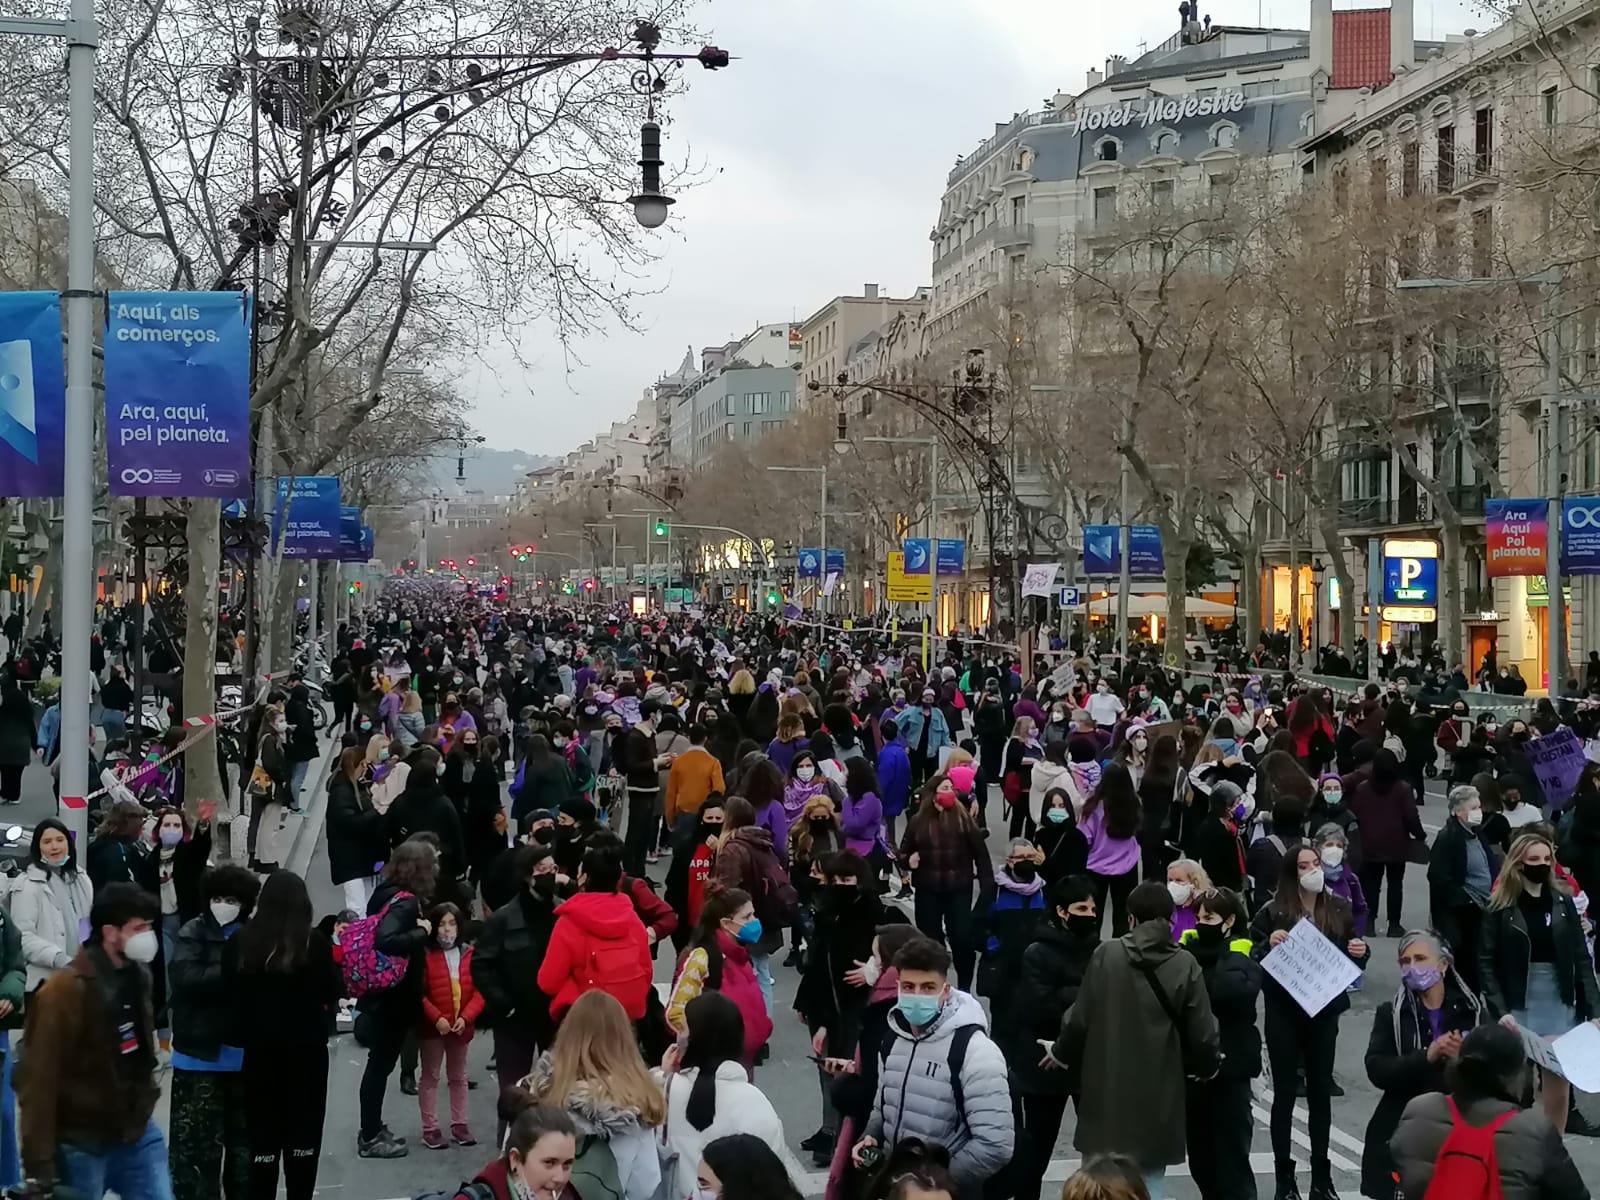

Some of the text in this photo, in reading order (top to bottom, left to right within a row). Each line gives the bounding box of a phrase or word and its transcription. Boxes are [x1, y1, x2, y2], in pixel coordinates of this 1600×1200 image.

[1072, 88, 1247, 138] Hotel Majestic
[116, 303, 200, 323] Aquí, als
[116, 327, 221, 347] comerços.
[120, 403, 209, 425] Ara, aquí,
[120, 425, 230, 447] pel planeta.
[1504, 511, 1527, 521] Ara
[1502, 521, 1531, 537] Aquí
[1492, 547, 1541, 561] planeta
[1401, 558, 1422, 588] P
[1063, 589, 1076, 604] P
